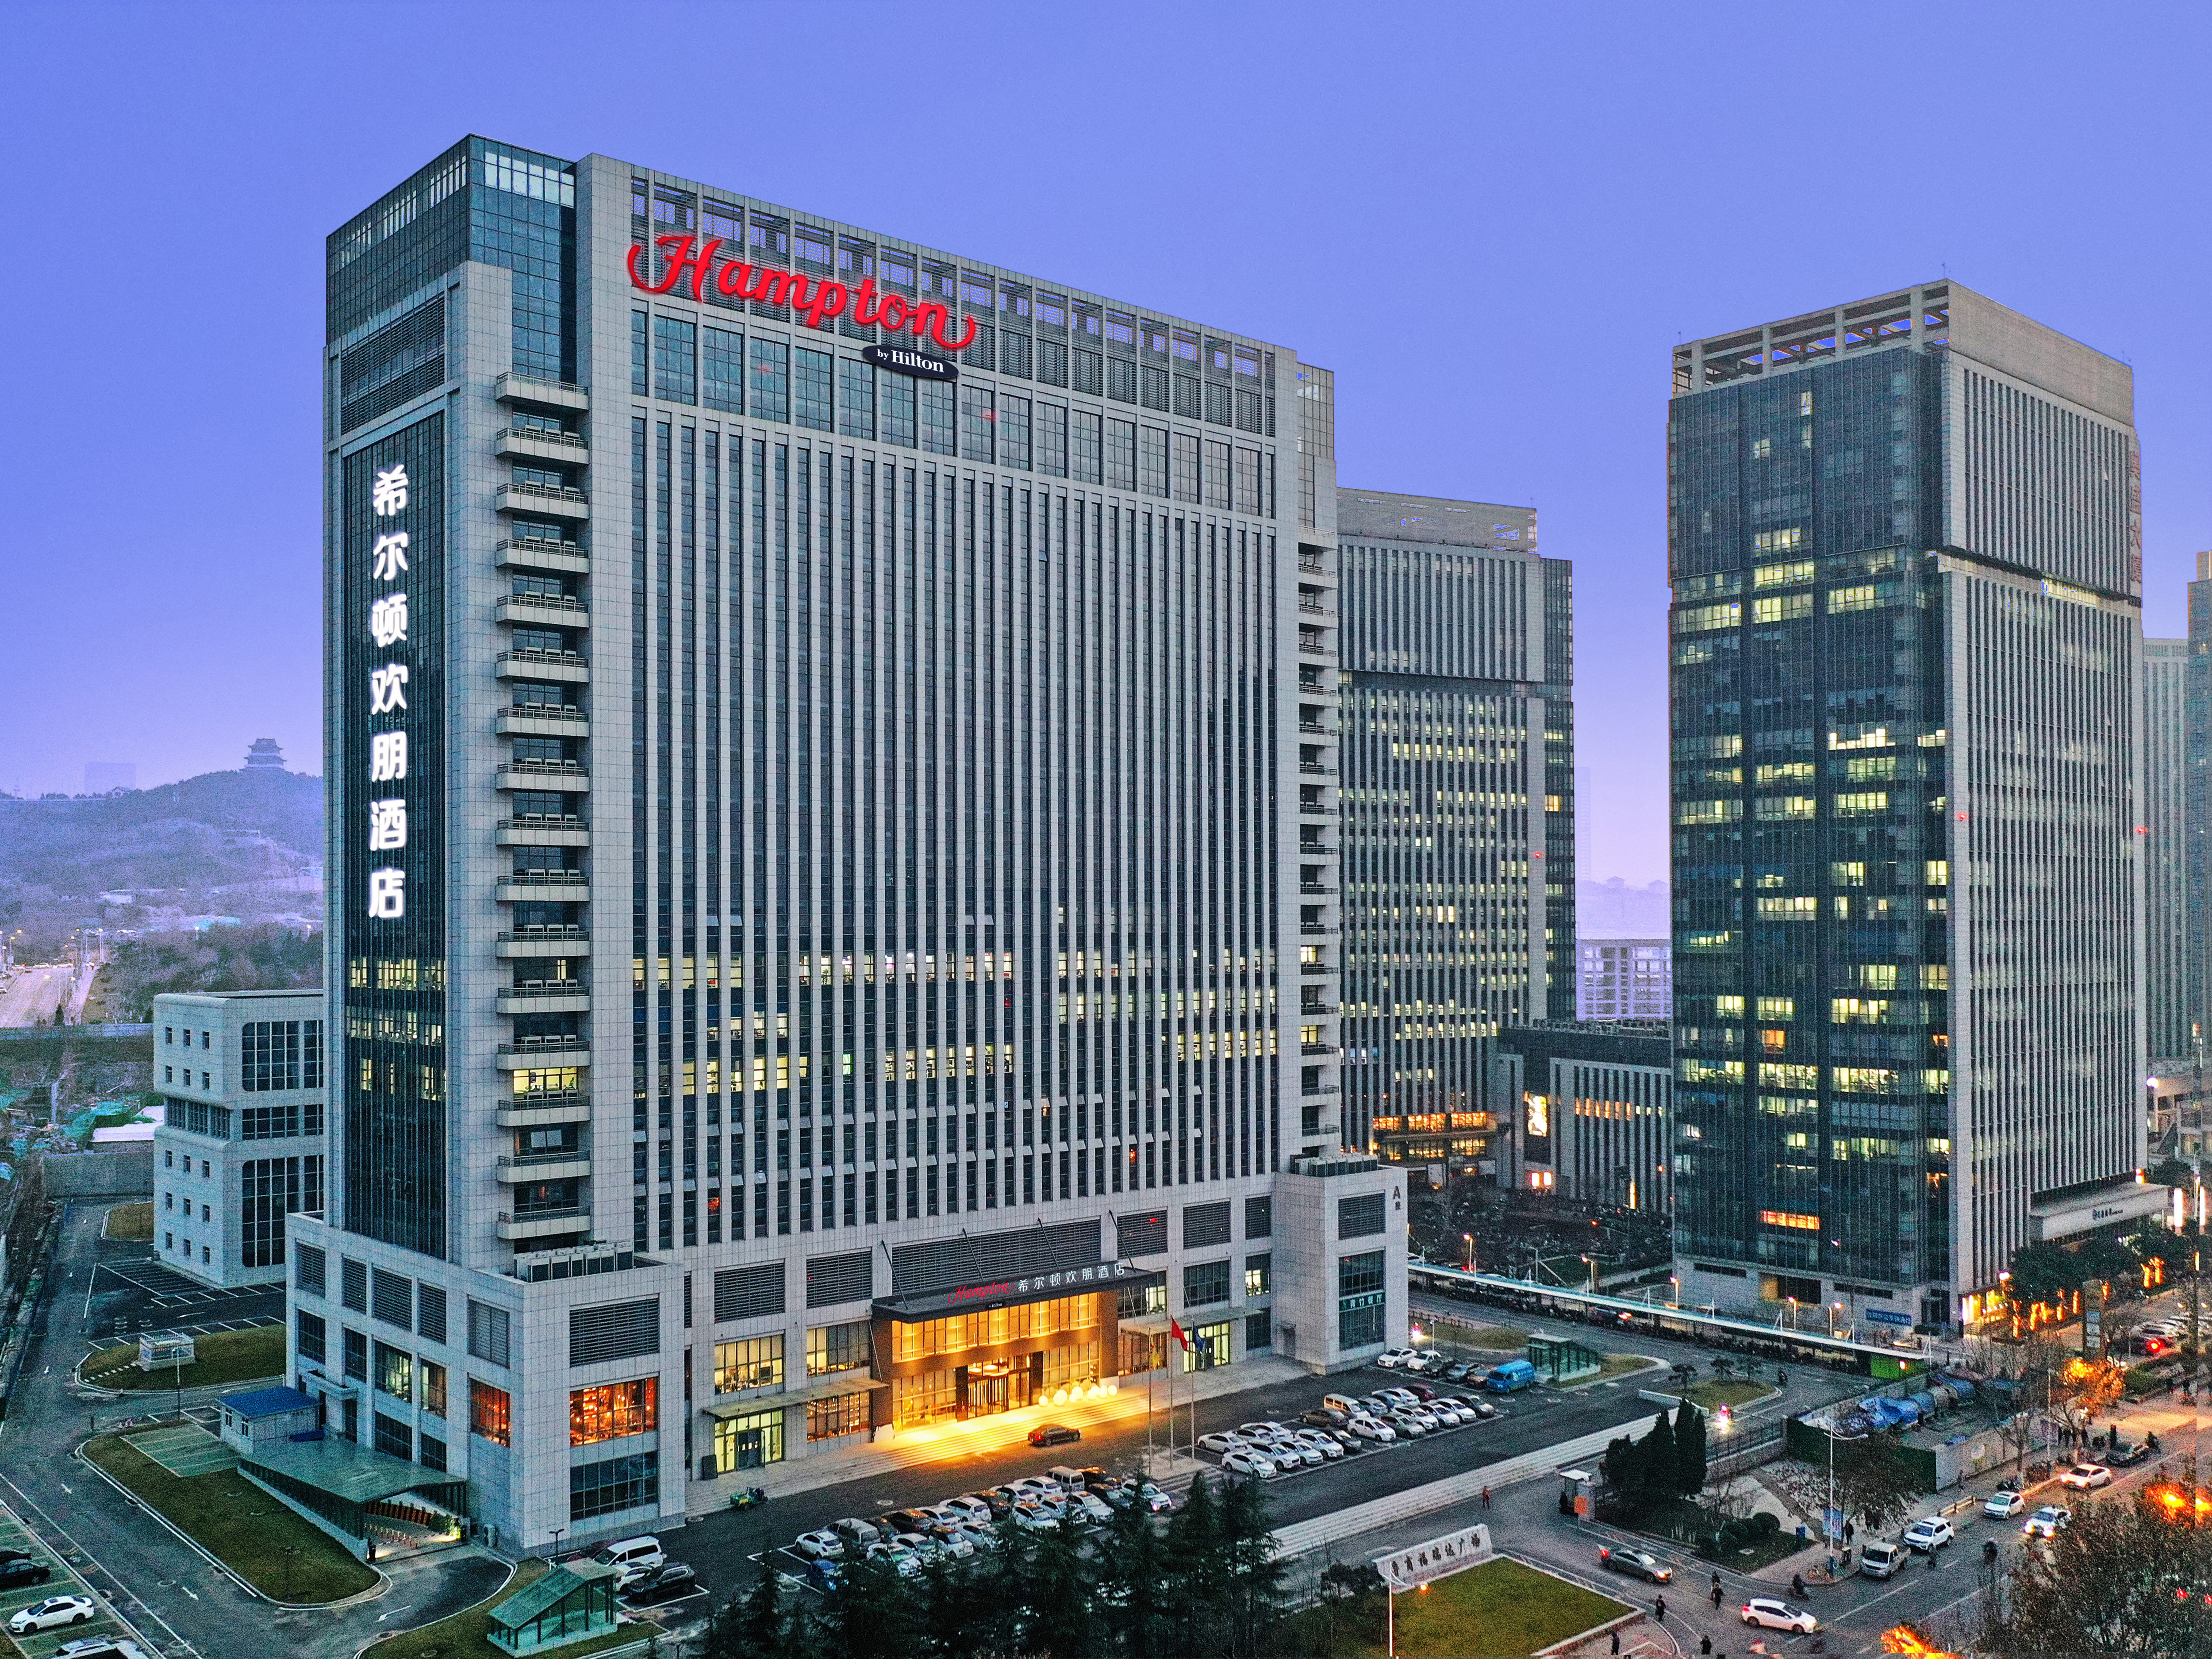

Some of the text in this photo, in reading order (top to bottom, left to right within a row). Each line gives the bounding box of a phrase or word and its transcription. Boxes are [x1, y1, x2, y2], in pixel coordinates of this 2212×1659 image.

[628, 237, 975, 348] Hampton
[877, 349, 944, 373] by Hilton
[368, 464, 409, 919] 希尔顿欢朋酒店
[1018, 1262, 1124, 1293] 希尔顿欢朋酒店
[948, 1282, 1013, 1305] Hampton
